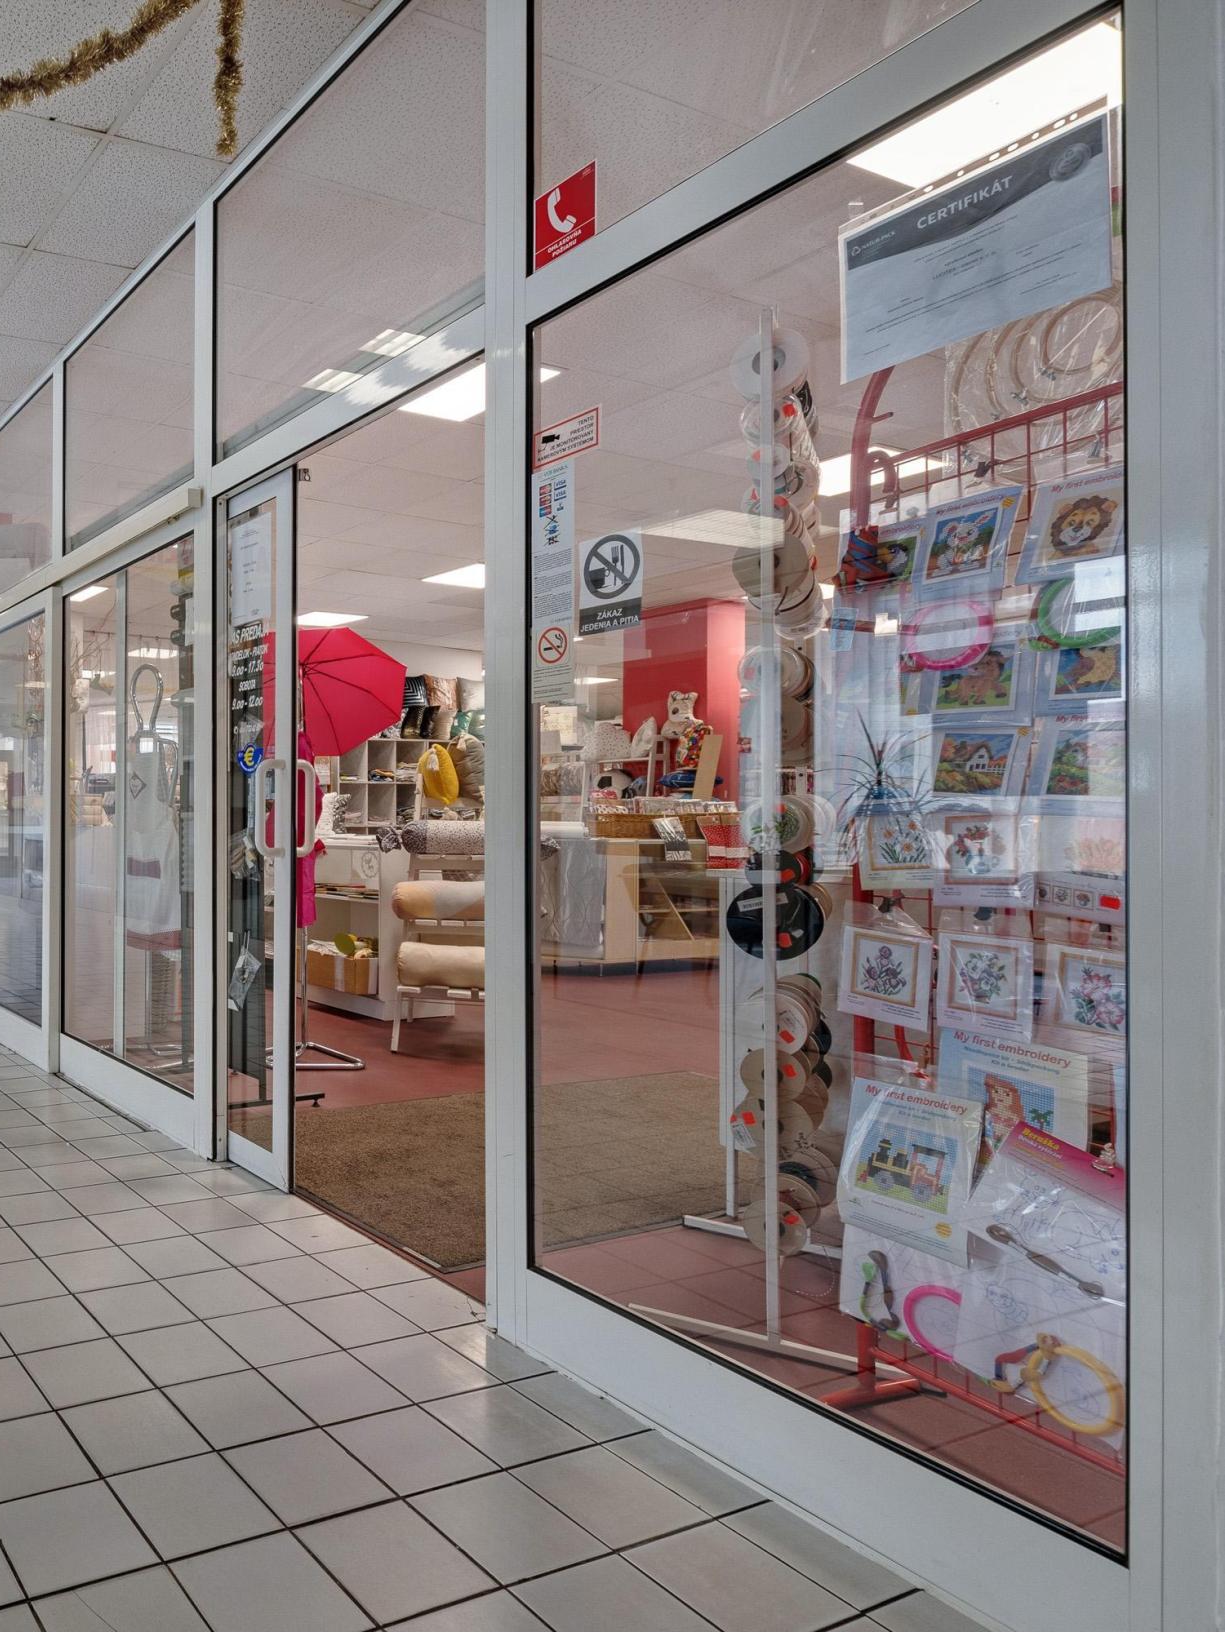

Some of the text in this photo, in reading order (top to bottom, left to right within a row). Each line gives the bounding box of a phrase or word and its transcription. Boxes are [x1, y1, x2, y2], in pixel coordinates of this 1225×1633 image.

[916, 175, 1014, 230] CERTIFIKÁT
[580, 620, 611, 633] JEDENIA
[612, 619, 619, 627] A
[619, 614, 640, 626] PITIA
[597, 608, 623, 620] ZÁKAZ
[954, 1031, 1071, 1069] My first embroidery
[865, 1084, 881, 1097] My
[906, 1095, 968, 1115] embroidery
